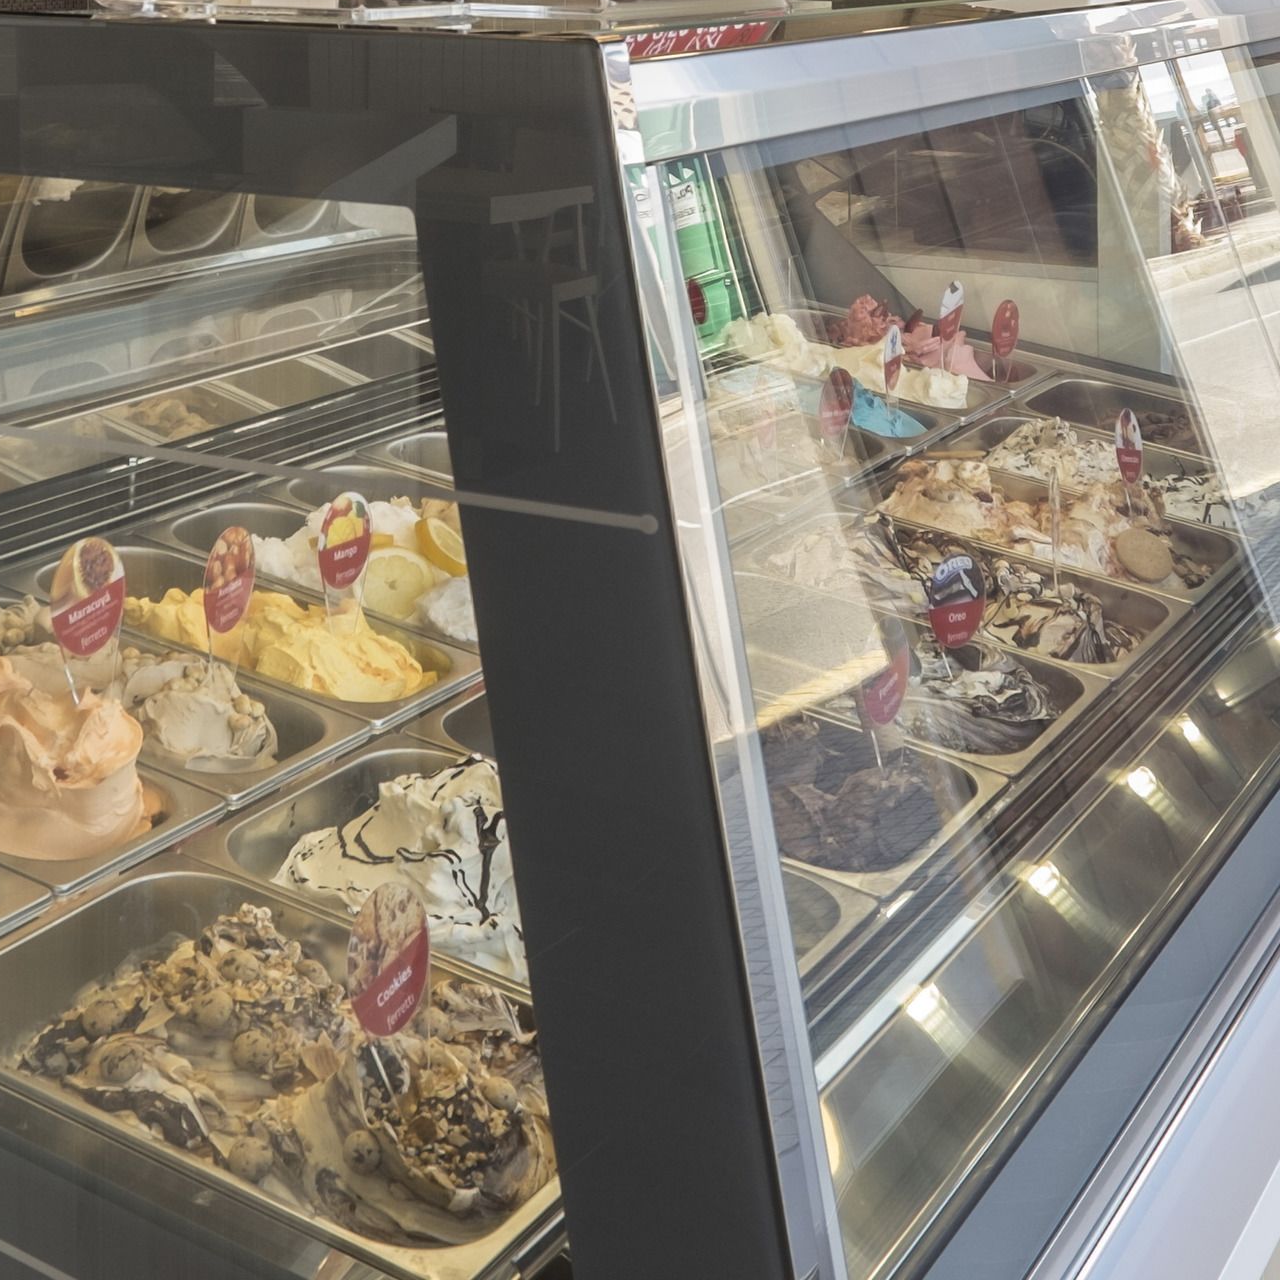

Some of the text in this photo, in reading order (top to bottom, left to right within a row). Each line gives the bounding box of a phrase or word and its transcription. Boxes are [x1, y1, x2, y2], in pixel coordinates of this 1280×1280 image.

[934, 555, 973, 581] OREO
[68, 591, 112, 624] Maracuyá
[948, 612, 967, 623] Oreo
[376, 965, 413, 1008] Cookies
